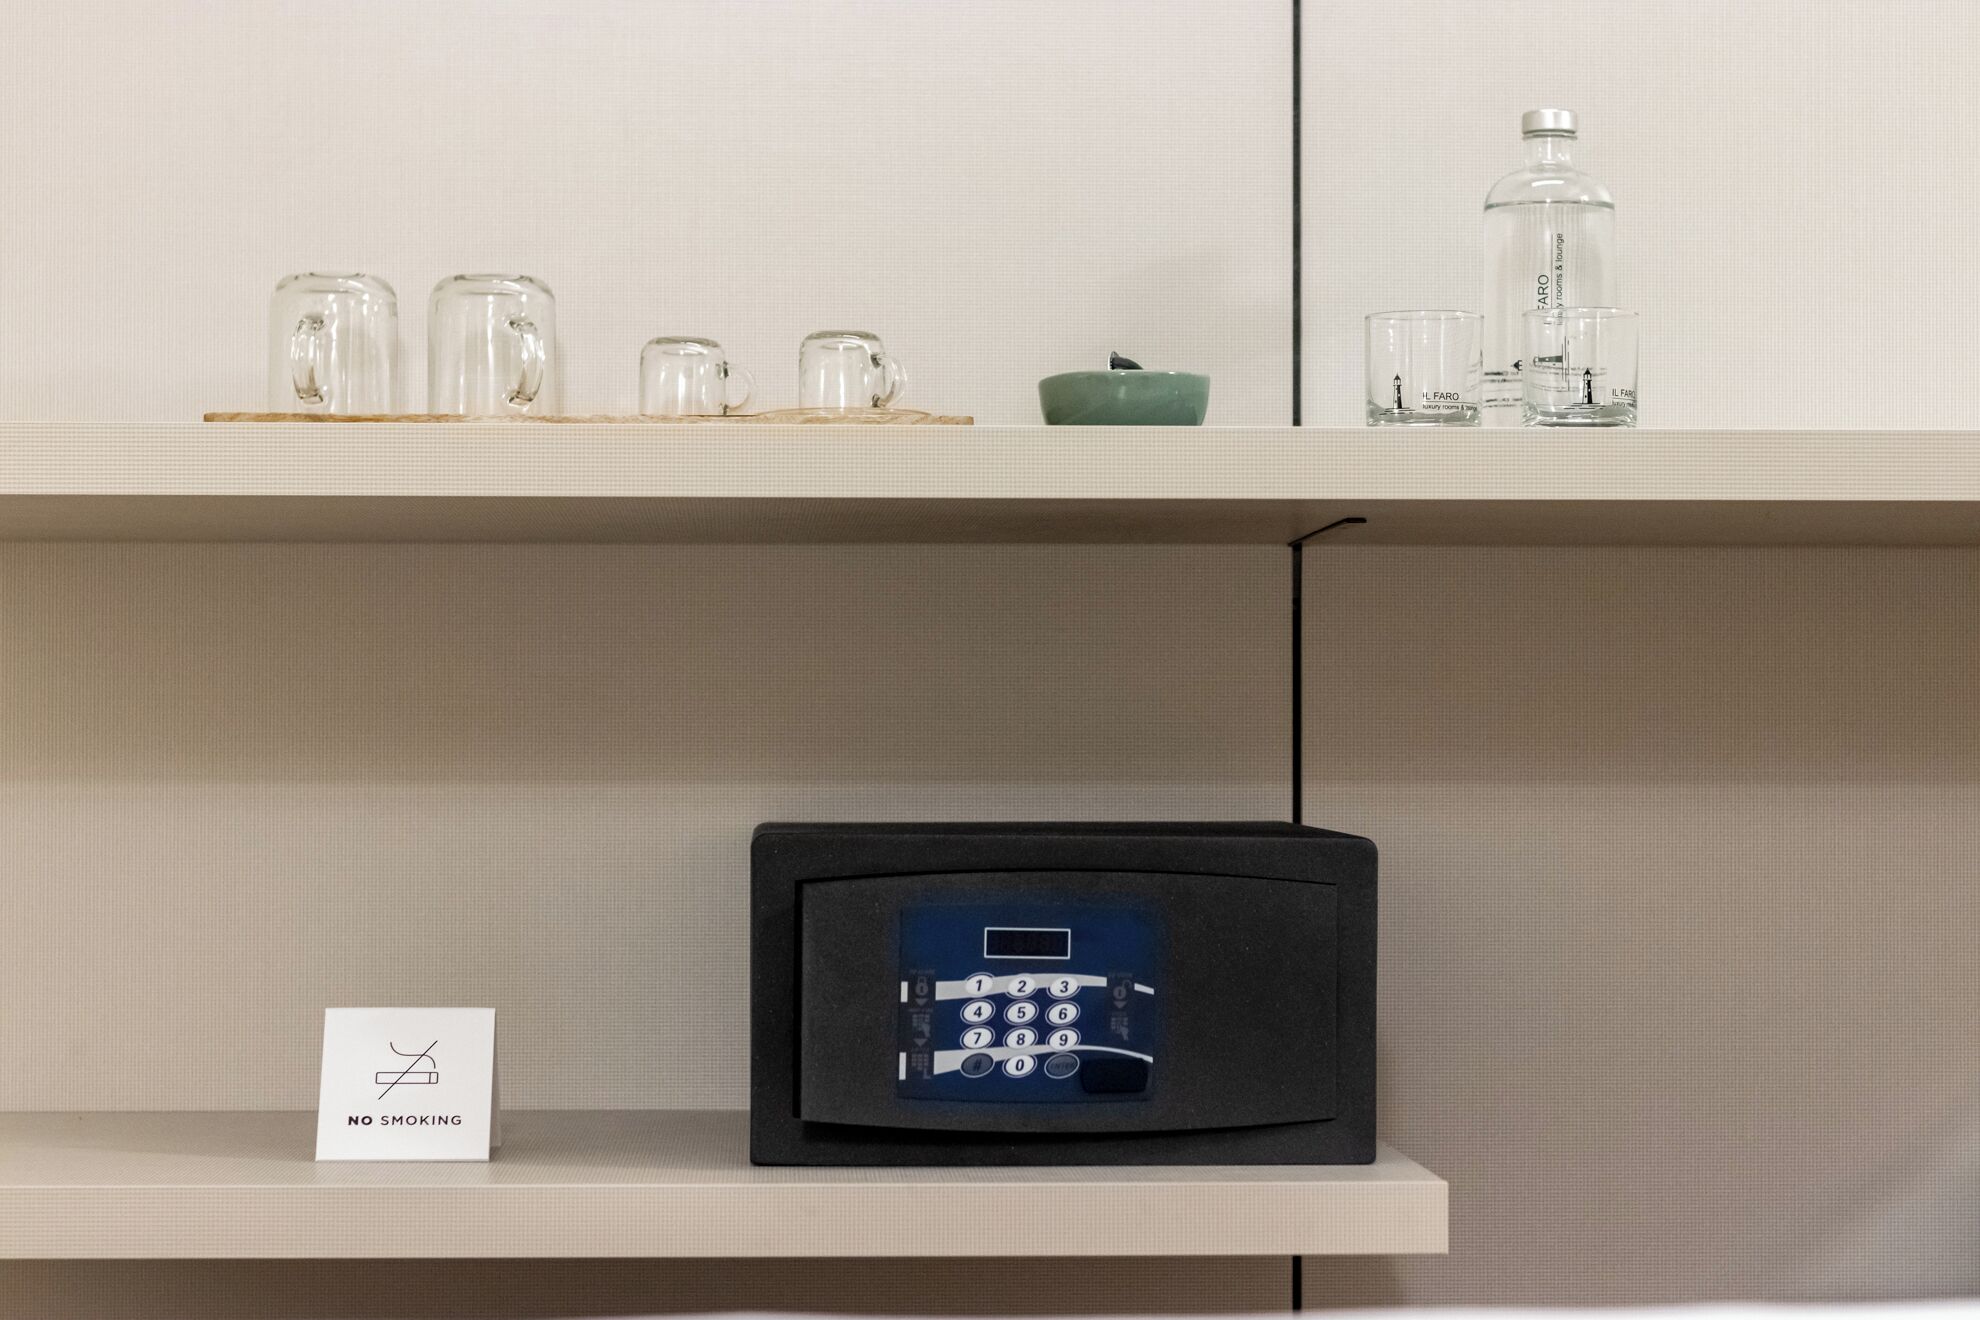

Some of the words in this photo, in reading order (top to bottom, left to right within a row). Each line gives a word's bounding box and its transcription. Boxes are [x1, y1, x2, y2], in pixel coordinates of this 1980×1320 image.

[1554, 232, 1565, 262] lounge
[1555, 273, 1563, 300] rooms
[1422, 391, 1431, 401] IL
[1433, 391, 1460, 401] FARO
[976, 979, 983, 992] 1
[1017, 980, 1027, 993] 2
[1060, 981, 1069, 994] 3
[973, 1006, 983, 1019] 4
[1017, 1006, 1026, 1019] 5
[1058, 1007, 1068, 1021] 6
[973, 1032, 982, 1045] 7
[1016, 1033, 1026, 1046] 8
[1059, 1034, 1069, 1047] 9
[1015, 1059, 1025, 1072] 0
[348, 1115, 373, 1126] NO
[380, 1115, 462, 1126] SMOKING
